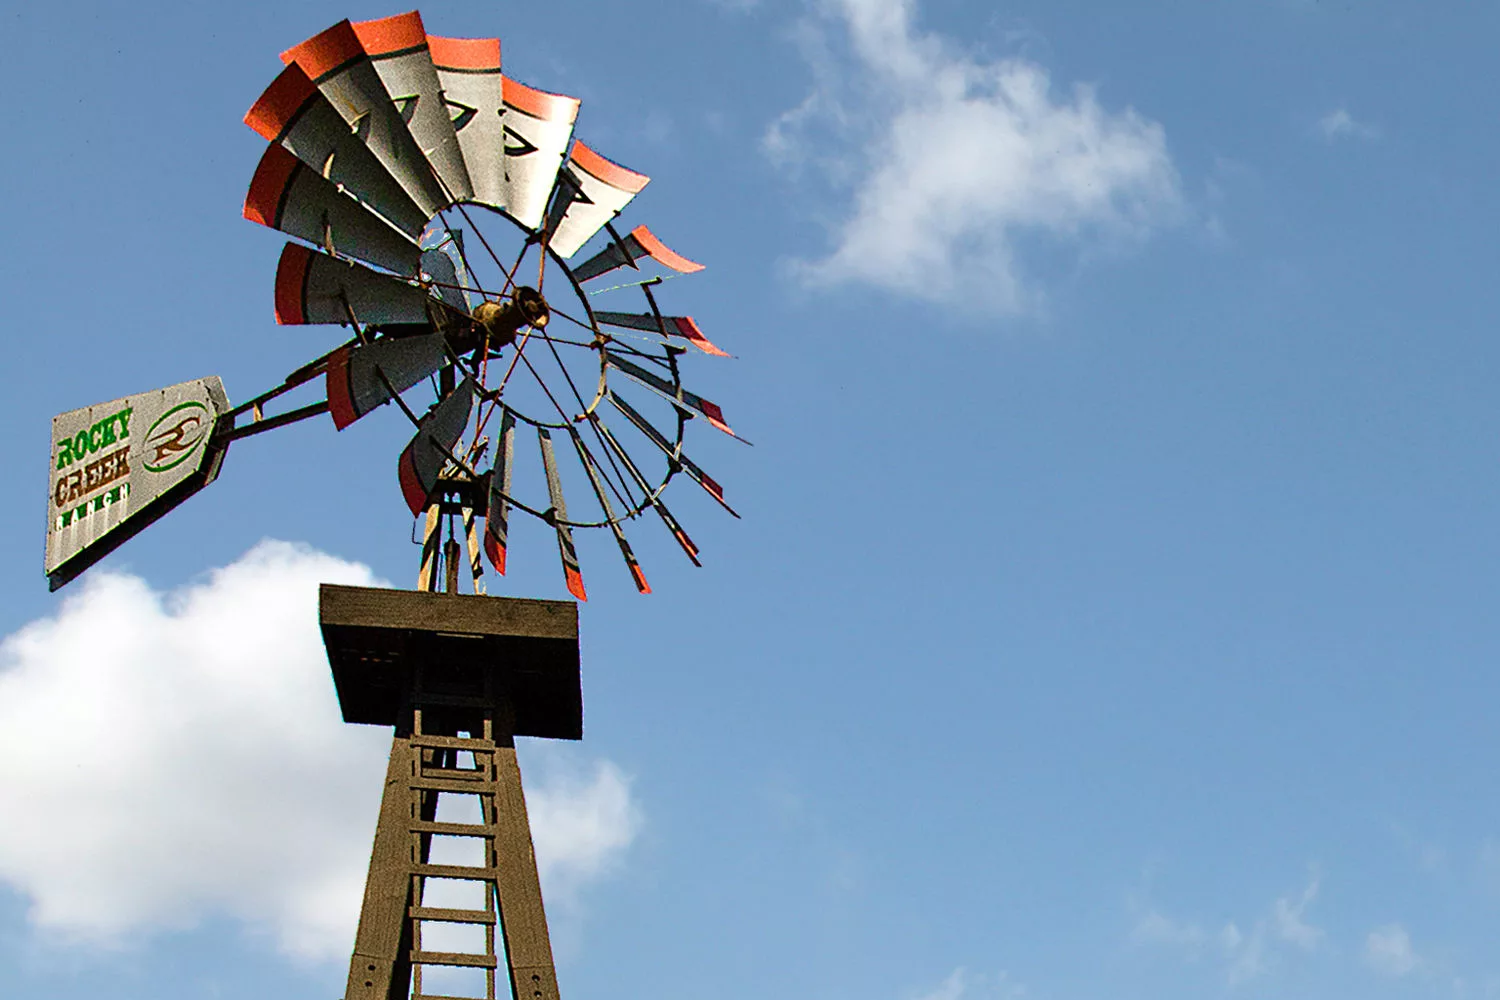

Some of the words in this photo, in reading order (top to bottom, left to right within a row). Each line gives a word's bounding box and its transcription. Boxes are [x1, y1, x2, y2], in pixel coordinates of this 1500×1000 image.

[57, 408, 133, 469] ROCKY
[55, 446, 130, 507] CREEK
[56, 483, 130, 531] RANCH
